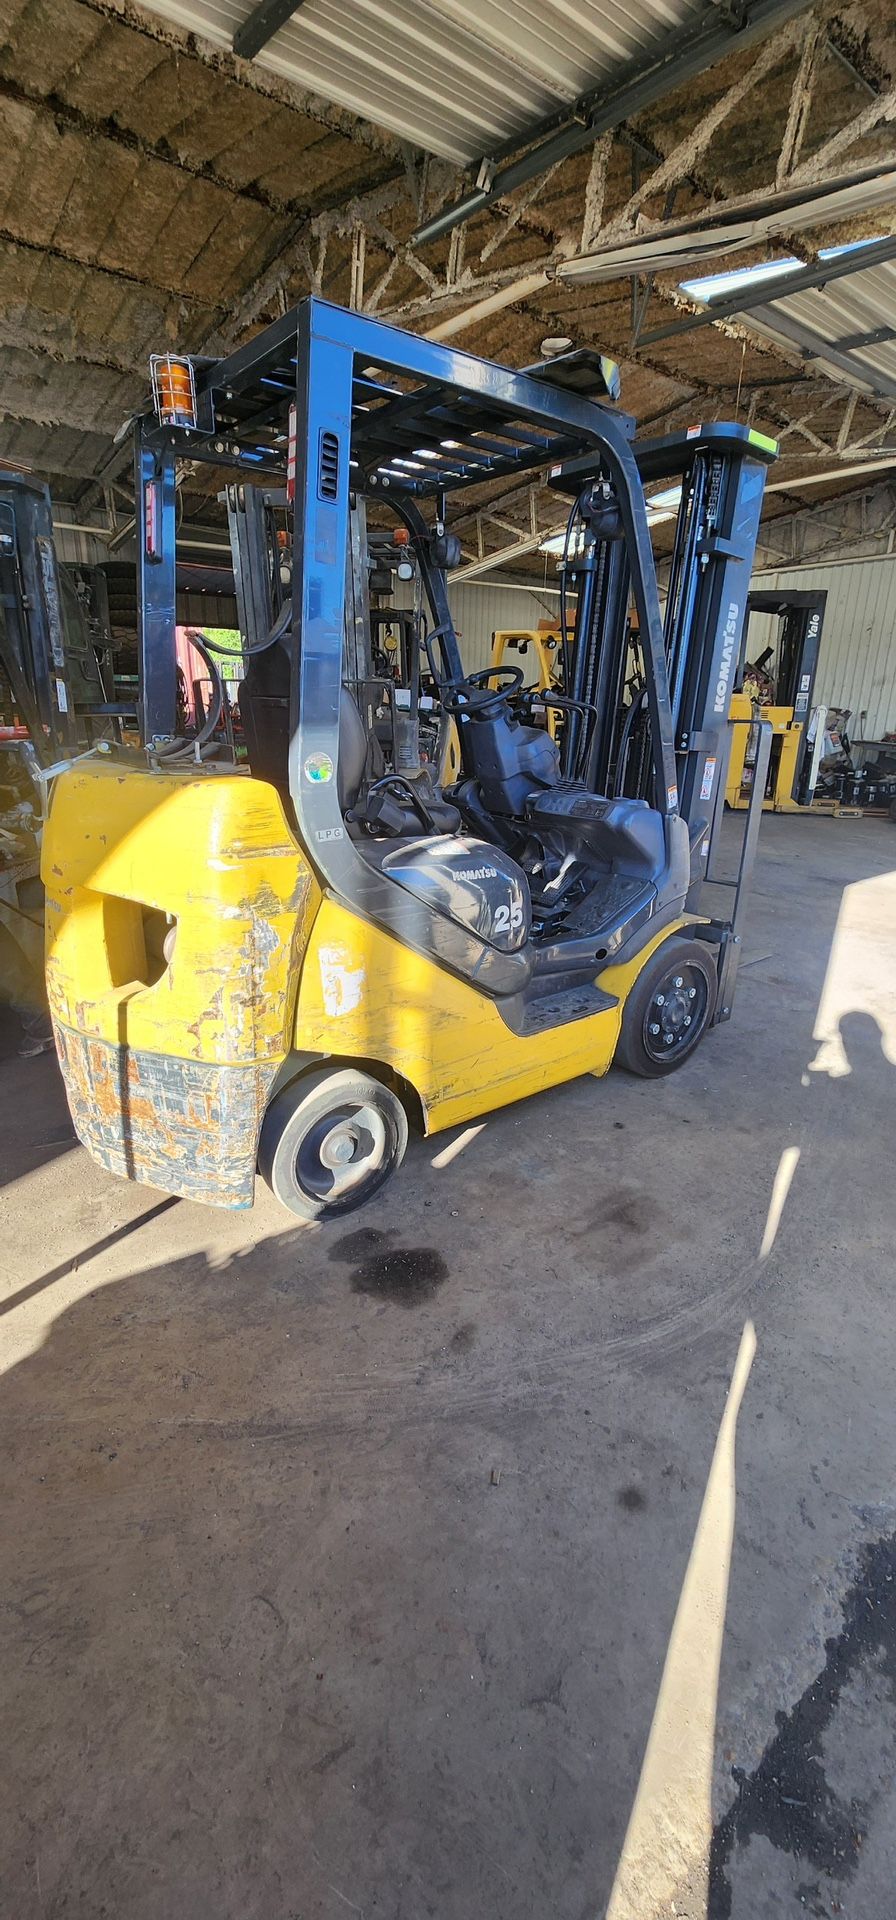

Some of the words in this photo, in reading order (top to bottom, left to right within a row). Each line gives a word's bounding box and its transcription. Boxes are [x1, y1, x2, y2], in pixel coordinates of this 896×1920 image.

[807, 614, 820, 639] Yale
[713, 603, 739, 713] KOMATSU
[317, 828, 341, 840] LPG
[452, 866, 497, 881] KOMATSU
[494, 902, 523, 933] 25
